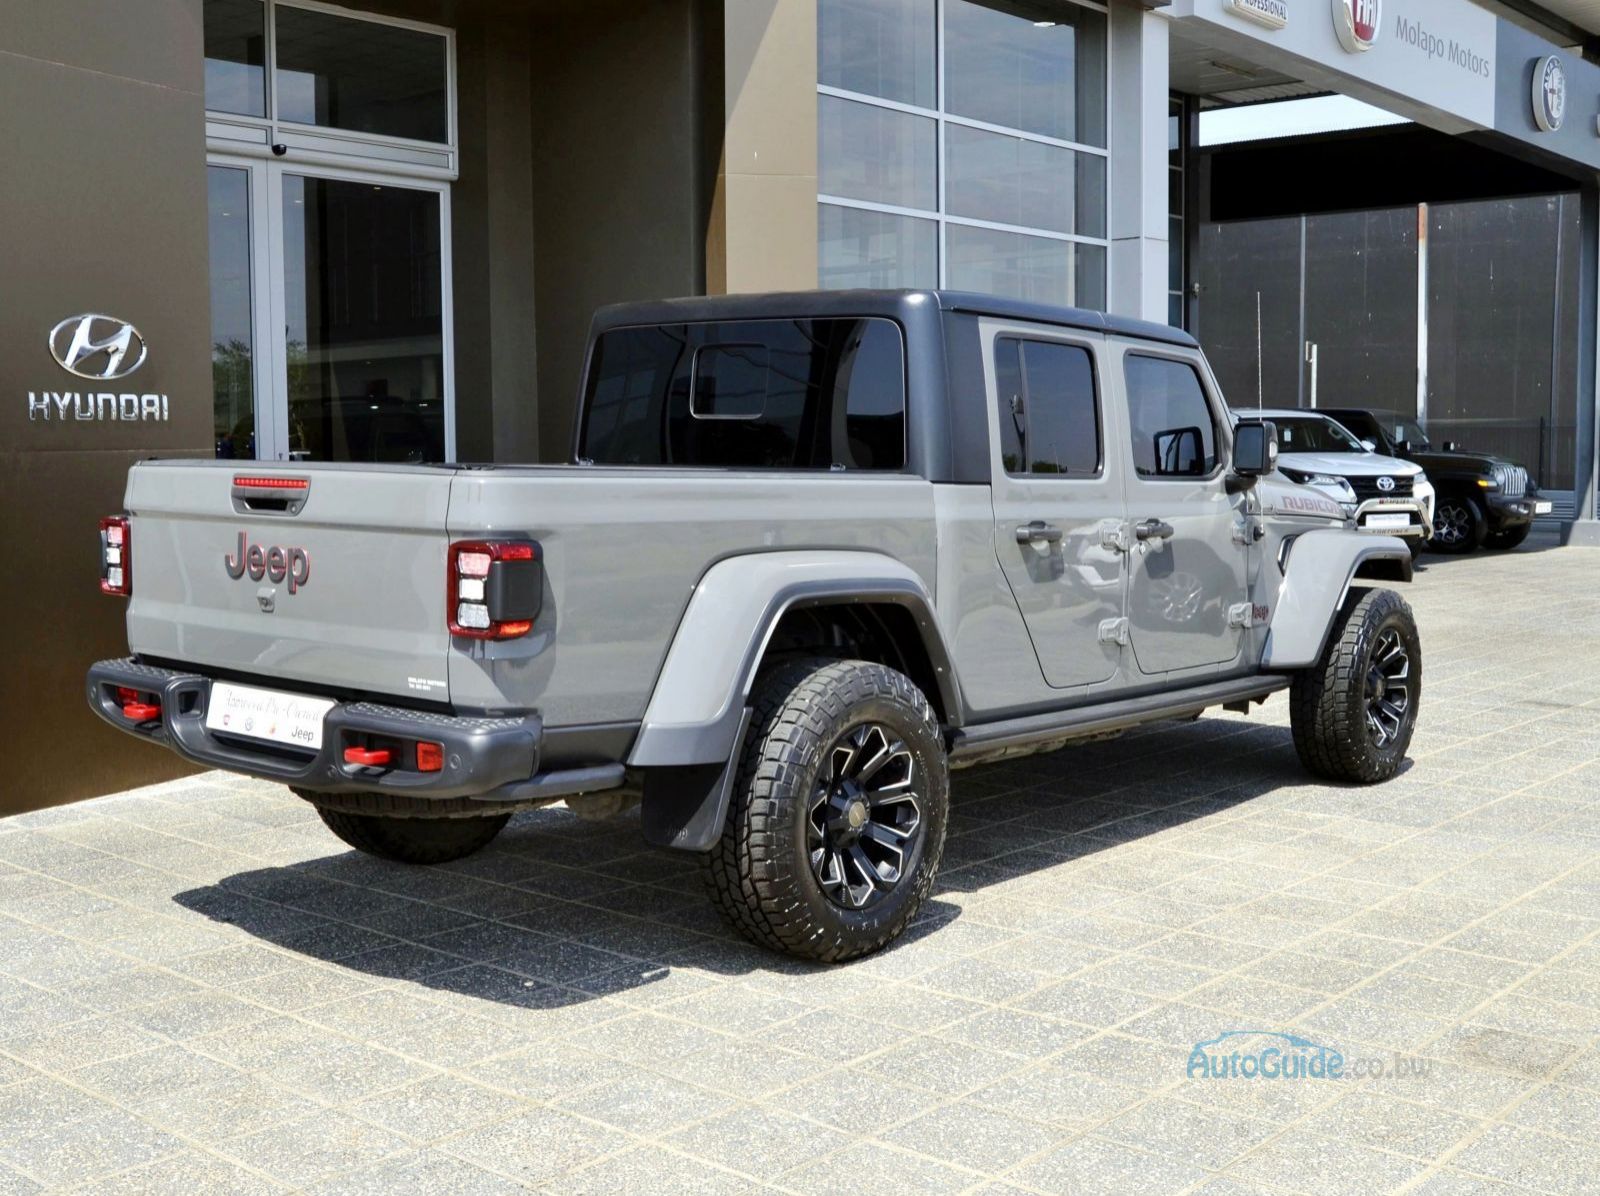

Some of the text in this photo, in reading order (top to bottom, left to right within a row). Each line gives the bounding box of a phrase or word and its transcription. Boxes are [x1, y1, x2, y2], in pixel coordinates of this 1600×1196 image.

[1396, 15, 1490, 78] Molapo Motors
[28, 391, 169, 421] HYUNDAI
[225, 531, 310, 595] Jeep
[291, 726, 314, 742] Jeep
